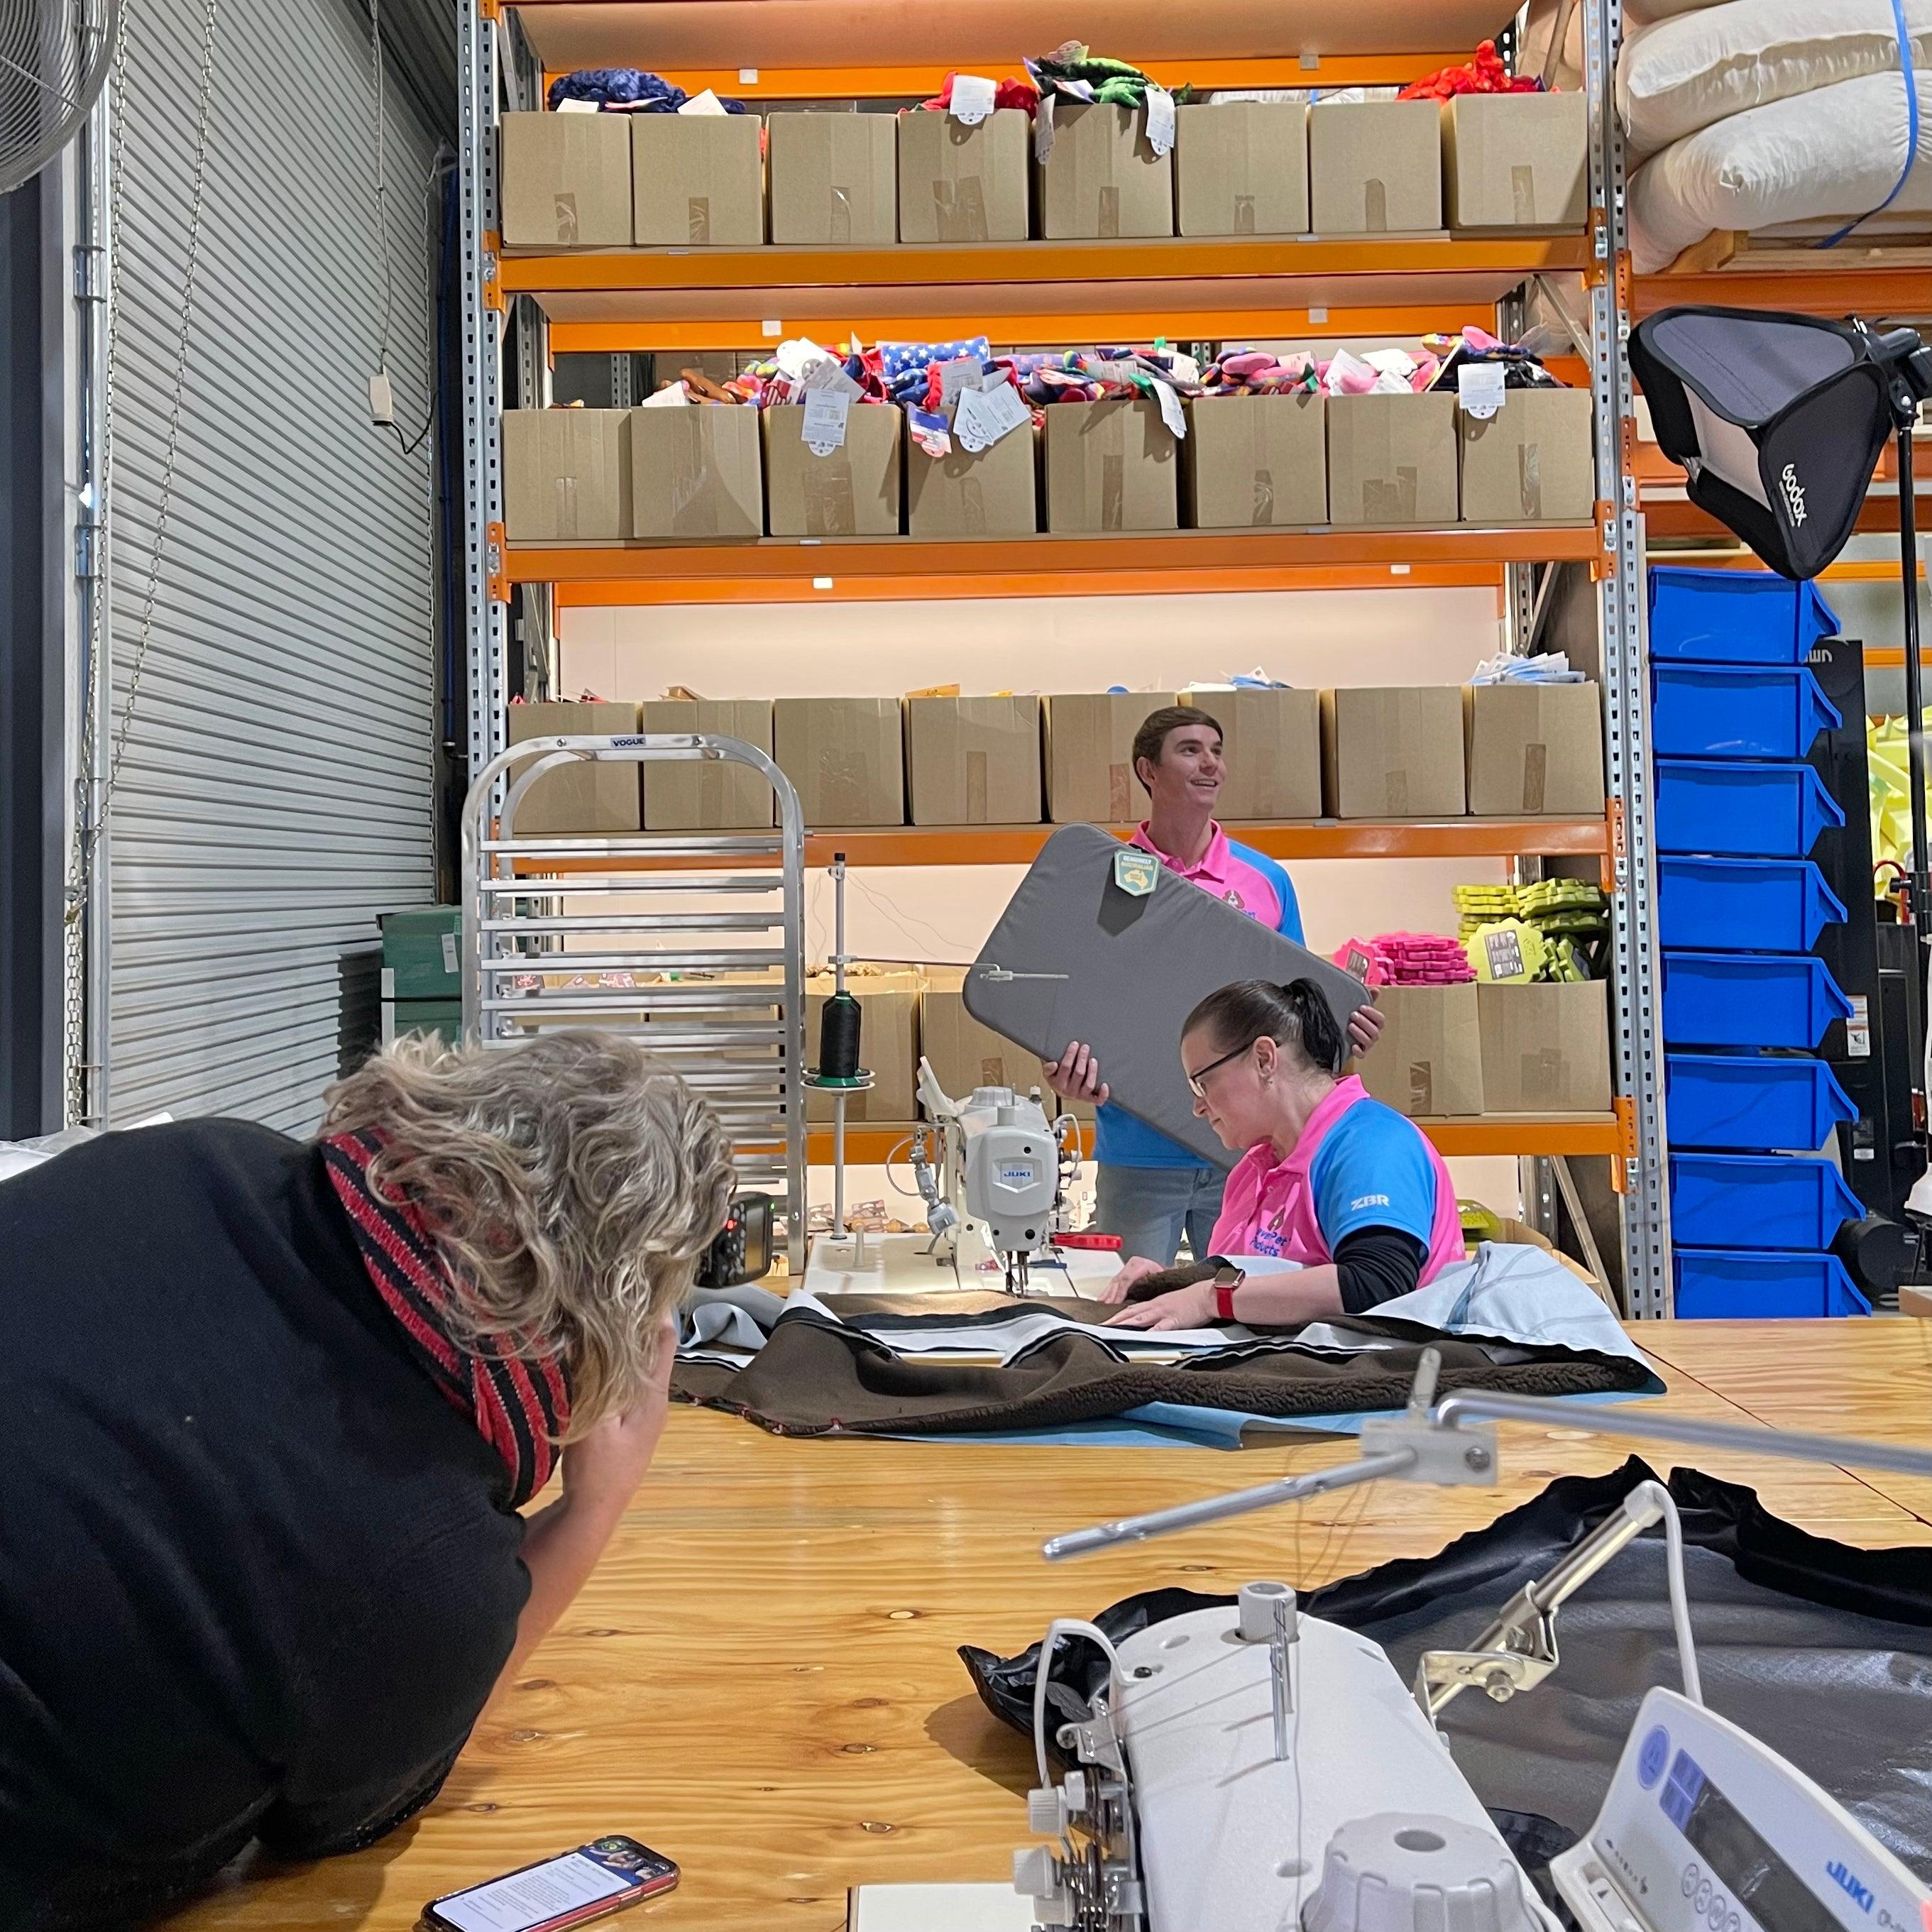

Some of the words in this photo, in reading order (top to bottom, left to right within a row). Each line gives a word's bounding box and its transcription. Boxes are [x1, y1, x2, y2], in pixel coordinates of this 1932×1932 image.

[1782, 463, 1807, 527] Godox
[613, 737, 644, 747] VOGUE
[1351, 1194, 1390, 1212] ZBR
[1826, 1861, 1875, 1914] JUKI
